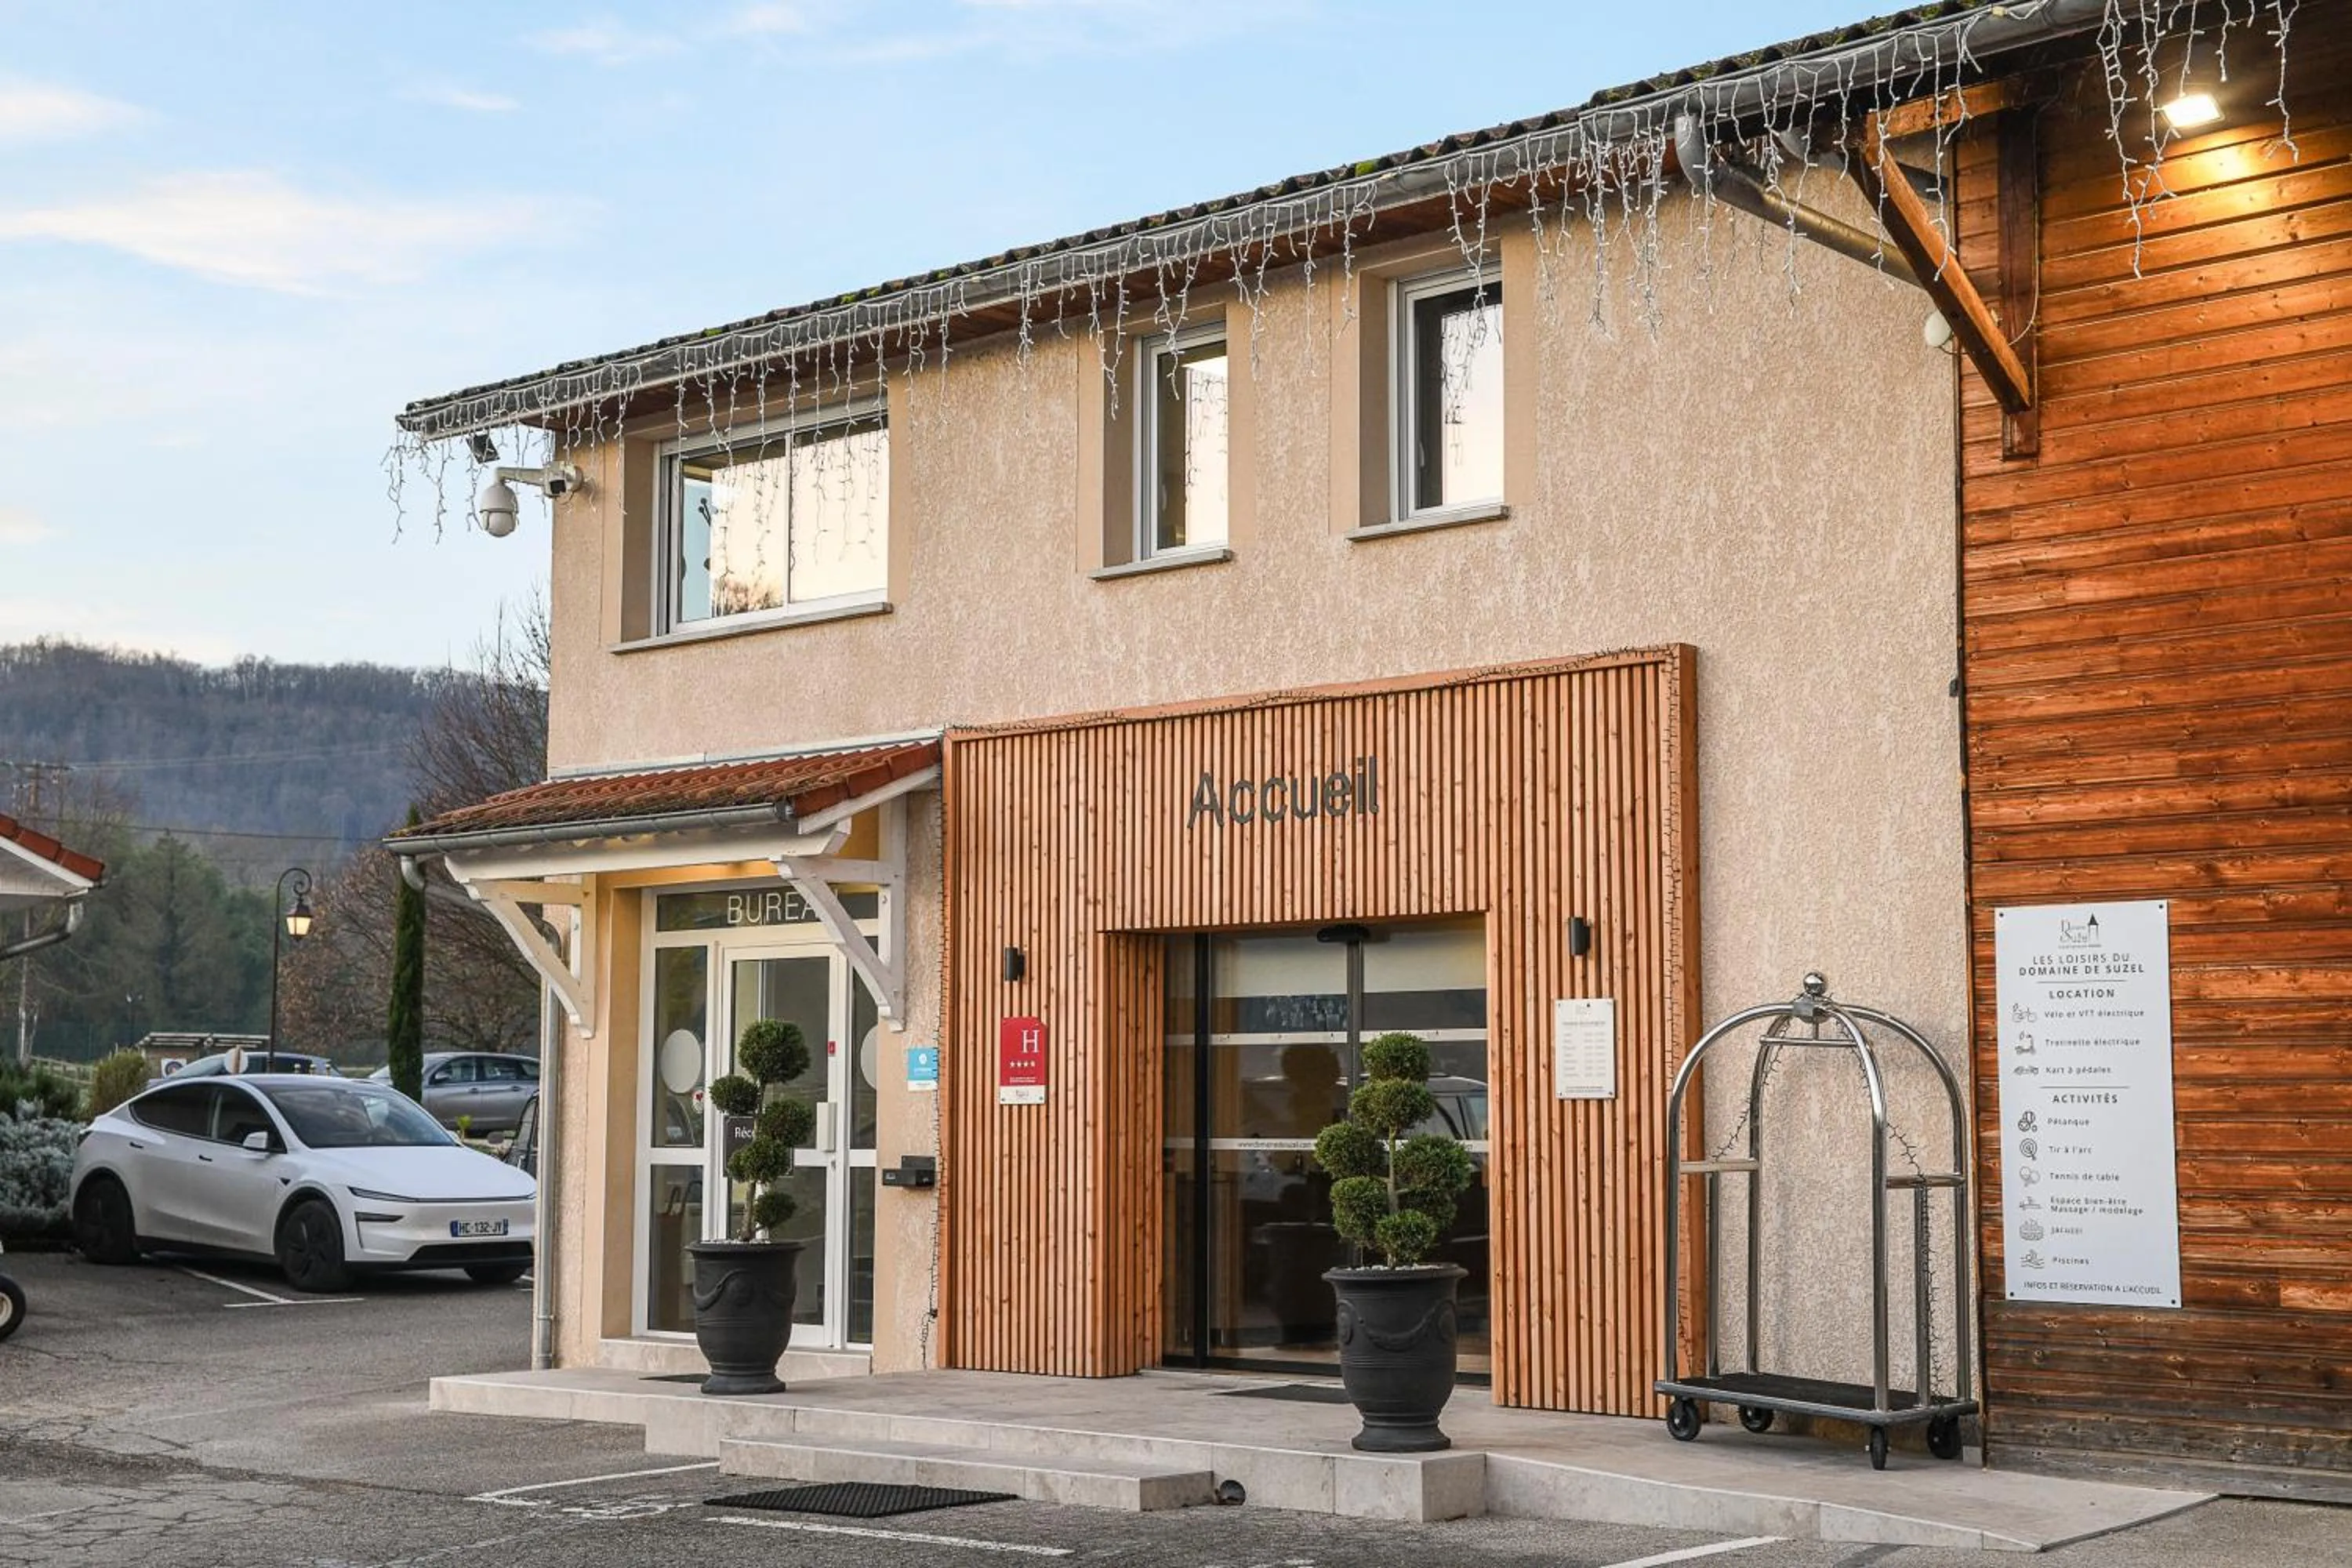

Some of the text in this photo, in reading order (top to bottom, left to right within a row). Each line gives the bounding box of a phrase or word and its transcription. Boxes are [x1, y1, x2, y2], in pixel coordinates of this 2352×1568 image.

[1187, 756, 1379, 829] Accueil
[727, 890, 837, 924] BUREA
[2033, 953, 2130, 965] LES LOISIRS DU
[2019, 964, 2145, 976] DOMAINE DE SUZEL
[2049, 989, 2115, 1000] LOCATION
[1022, 1029, 1040, 1054] H
[2045, 1066, 2064, 1075] Kart
[2052, 1093, 2118, 1104] ACTIVITÉS
[2047, 1117, 2090, 1127] Pétanque
[2073, 1145, 2092, 1155] l'arc
[2082, 1173, 2093, 1181] de
[2096, 1173, 2120, 1182] table
[2053, 1257, 2089, 1265] Piscines
